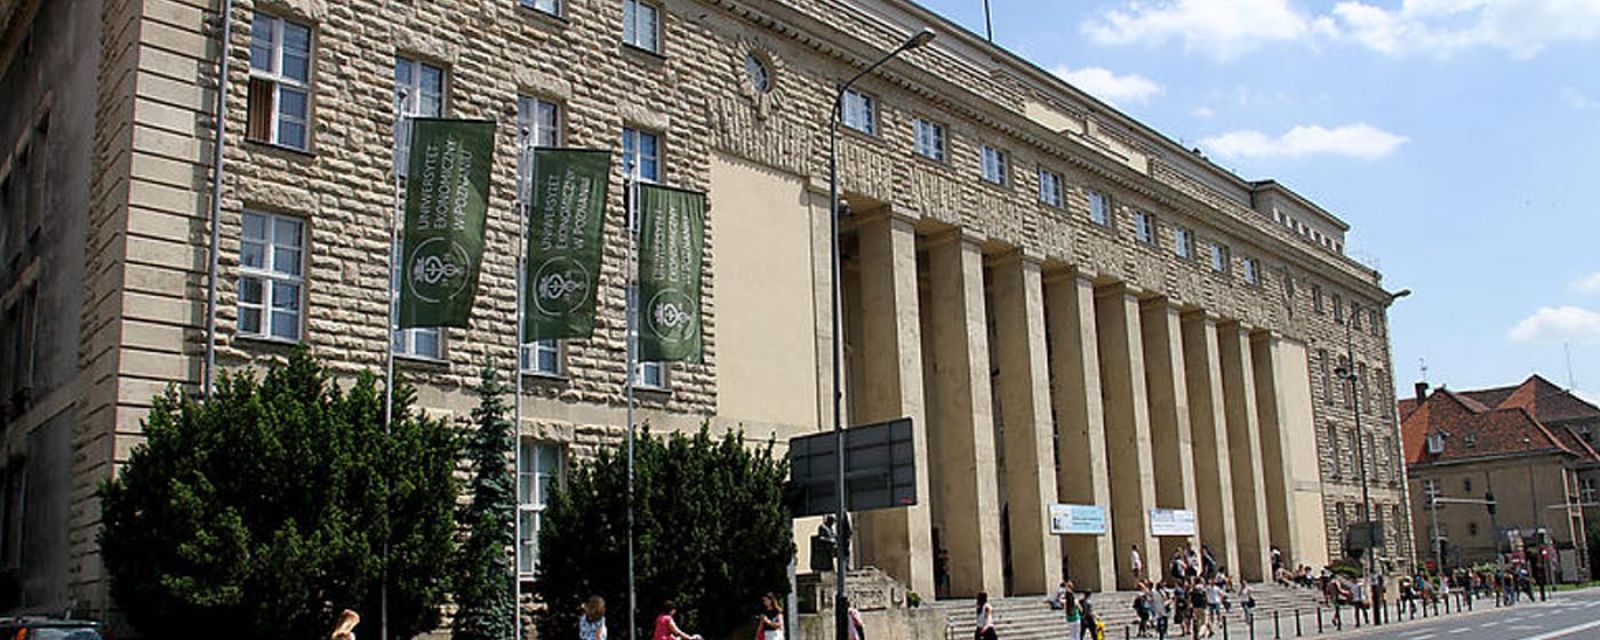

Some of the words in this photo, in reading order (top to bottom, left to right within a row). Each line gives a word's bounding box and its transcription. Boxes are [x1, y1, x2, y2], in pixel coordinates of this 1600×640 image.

[418, 145, 439, 230] UNIWERSYTET
[433, 139, 459, 230] EKONOMICZNY
[454, 151, 474, 214] POZNANIU
[453, 214, 466, 231] W
[572, 236, 585, 250] W
